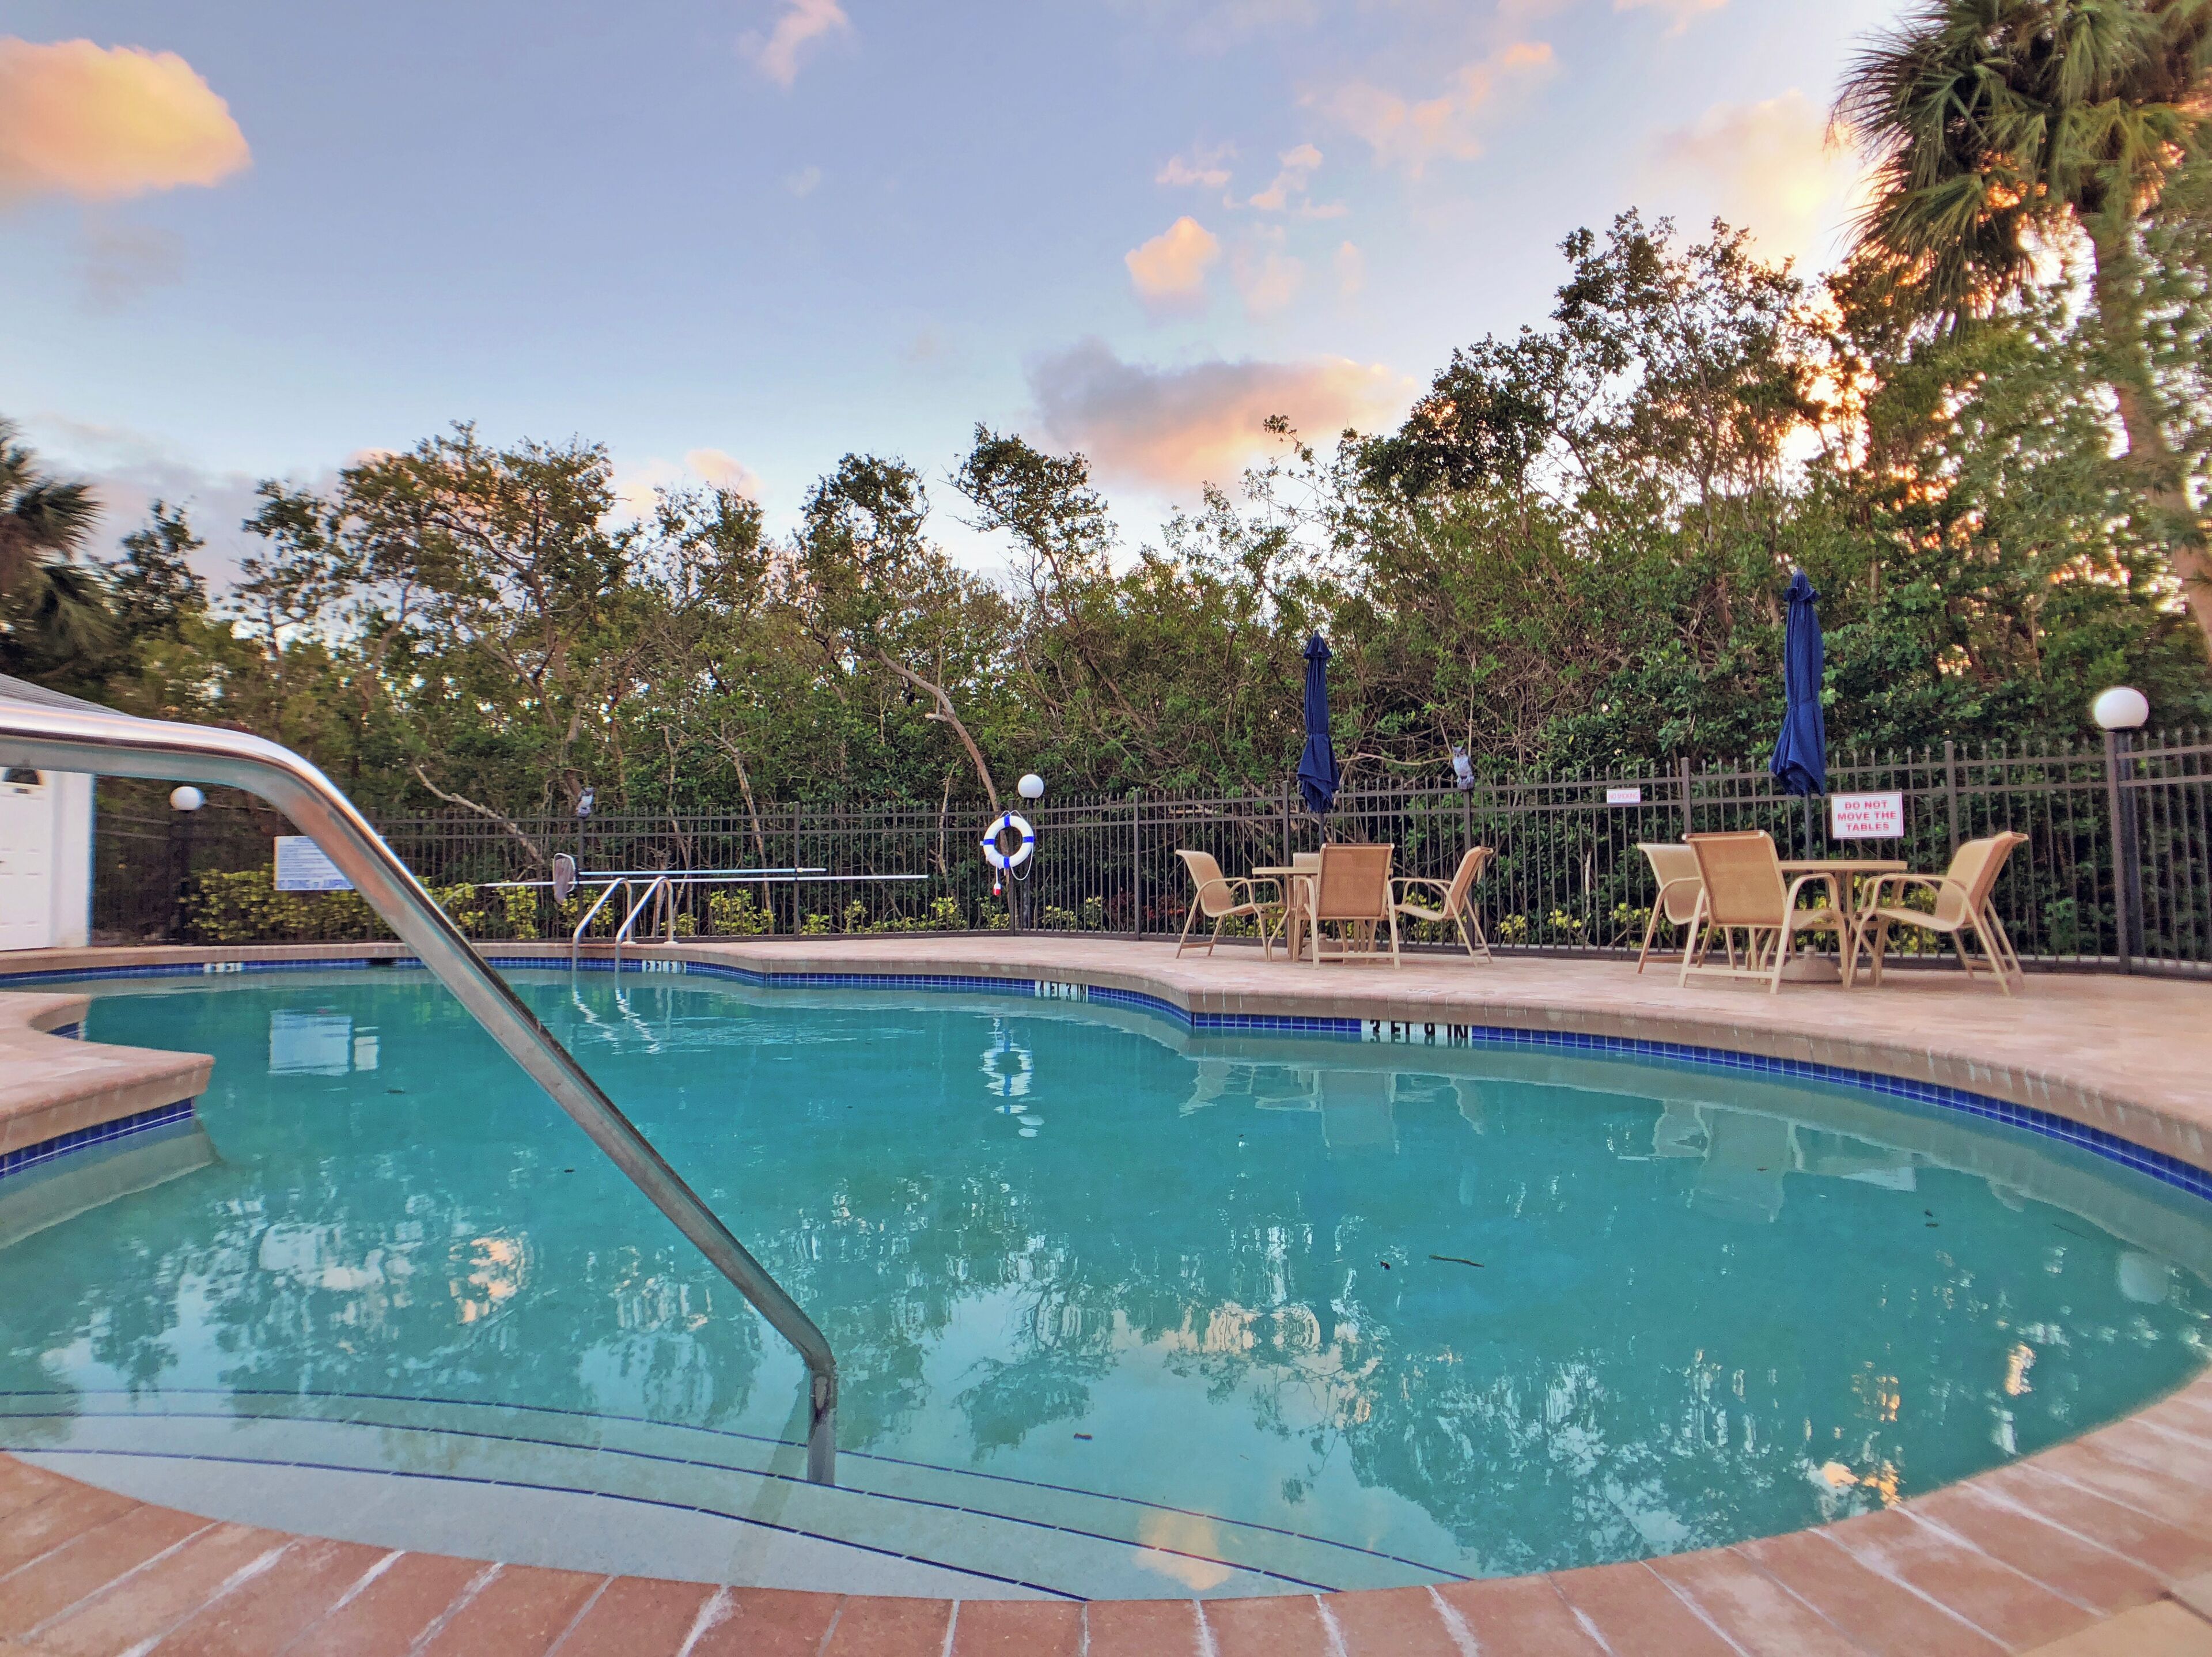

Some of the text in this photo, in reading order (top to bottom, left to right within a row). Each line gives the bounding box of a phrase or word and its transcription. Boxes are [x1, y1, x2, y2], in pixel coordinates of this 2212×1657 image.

[1844, 800, 1888, 810] DO NOT
[1838, 811, 1896, 821] MOVE THE
[1846, 822, 1890, 831] TABLES
[1391, 1020, 1414, 1035] FT
[1447, 1023, 1468, 1038] IN
